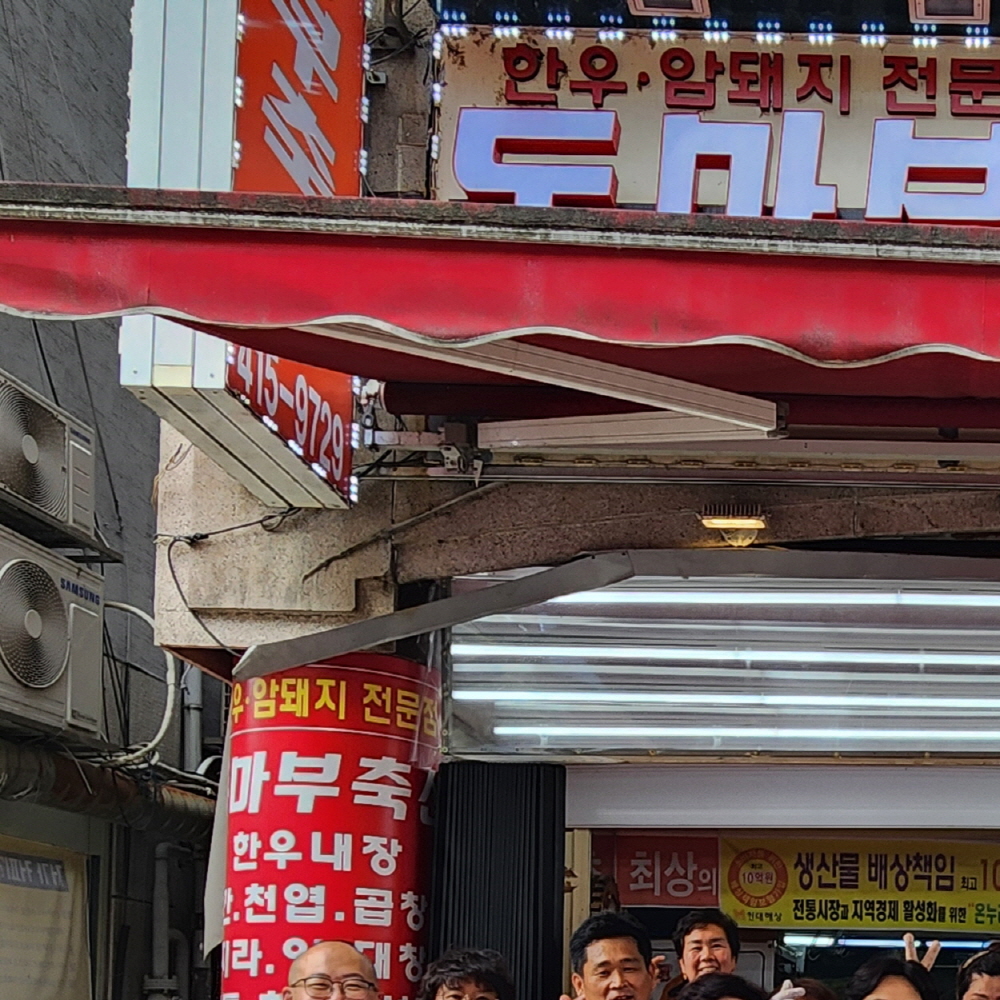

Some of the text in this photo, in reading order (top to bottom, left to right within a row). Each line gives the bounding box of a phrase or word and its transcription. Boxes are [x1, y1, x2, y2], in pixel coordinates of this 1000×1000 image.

[60, 577, 100, 605] SAMSUNG
[233, 829, 402, 876] 한우내장
[629, 851, 717, 898] 최상의
[742, 872, 774, 885] 10억원
[794, 852, 860, 891] 생산물
[868, 852, 955, 892] 배상책임
[961, 876, 977, 891] 최고
[793, 898, 849, 922] 전통시장과
[852, 900, 899, 922] 지역경제
[903, 900, 946, 923] 활성화를
[949, 906, 967, 923] 위한
